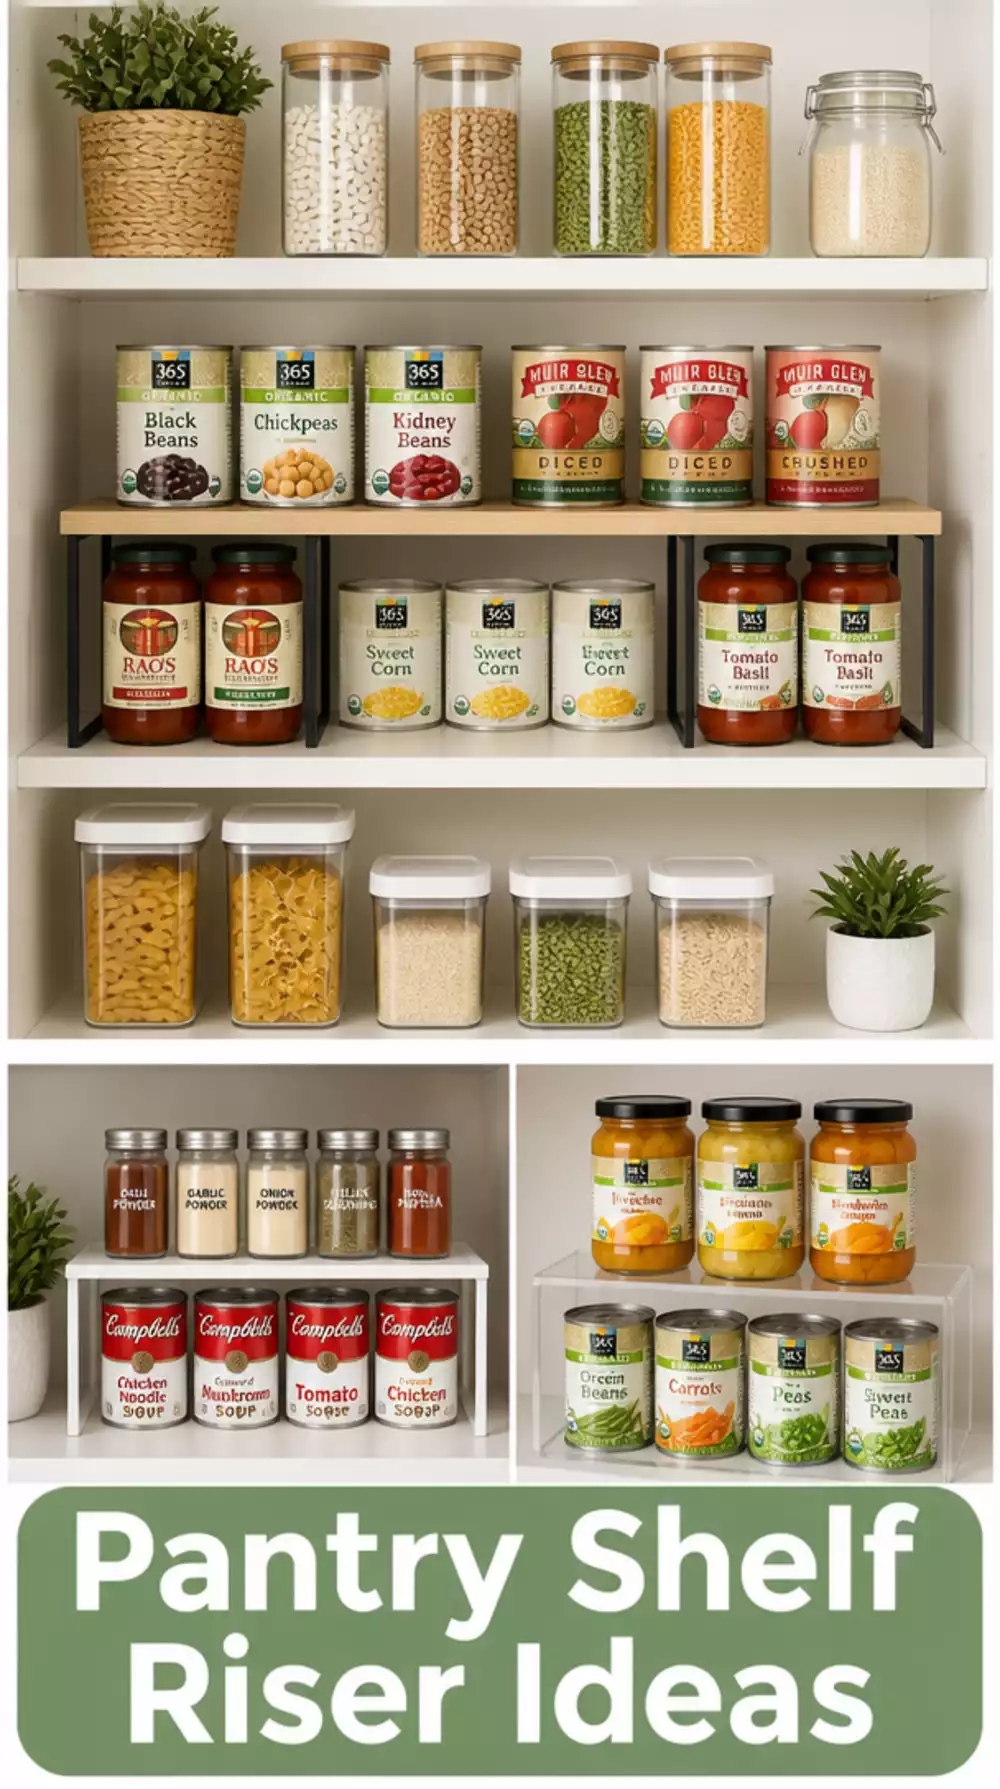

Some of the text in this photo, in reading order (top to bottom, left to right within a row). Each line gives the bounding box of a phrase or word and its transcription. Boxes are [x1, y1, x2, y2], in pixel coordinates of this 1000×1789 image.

[156, 363, 187, 379] 365
[280, 363, 311, 379] 365
[408, 364, 440, 379] 365
[530, 363, 569, 382] MUIR
[144, 412, 197, 429] Black
[254, 413, 338, 435] Chickpeas
[393, 412, 457, 434] Kidney
[144, 431, 198, 448] Beans
[397, 432, 452, 448] Beans
[538, 456, 603, 469] DICED
[668, 456, 733, 469] DICED
[782, 456, 868, 470] CRUSHED
[722, 649, 779, 665] Tomato
[824, 649, 883, 665] Tomato
[123, 657, 176, 674] RAO'S
[225, 657, 278, 675] RAO'S
[371, 661, 412, 676] Corn
[478, 661, 519, 676] Corn
[584, 661, 626, 677] Corn
[295, 1384, 359, 1402] Tomato
[387, 1386, 447, 1403] Chicken
[669, 1378, 723, 1396] Carrots
[772, 1386, 813, 1404] Peas
